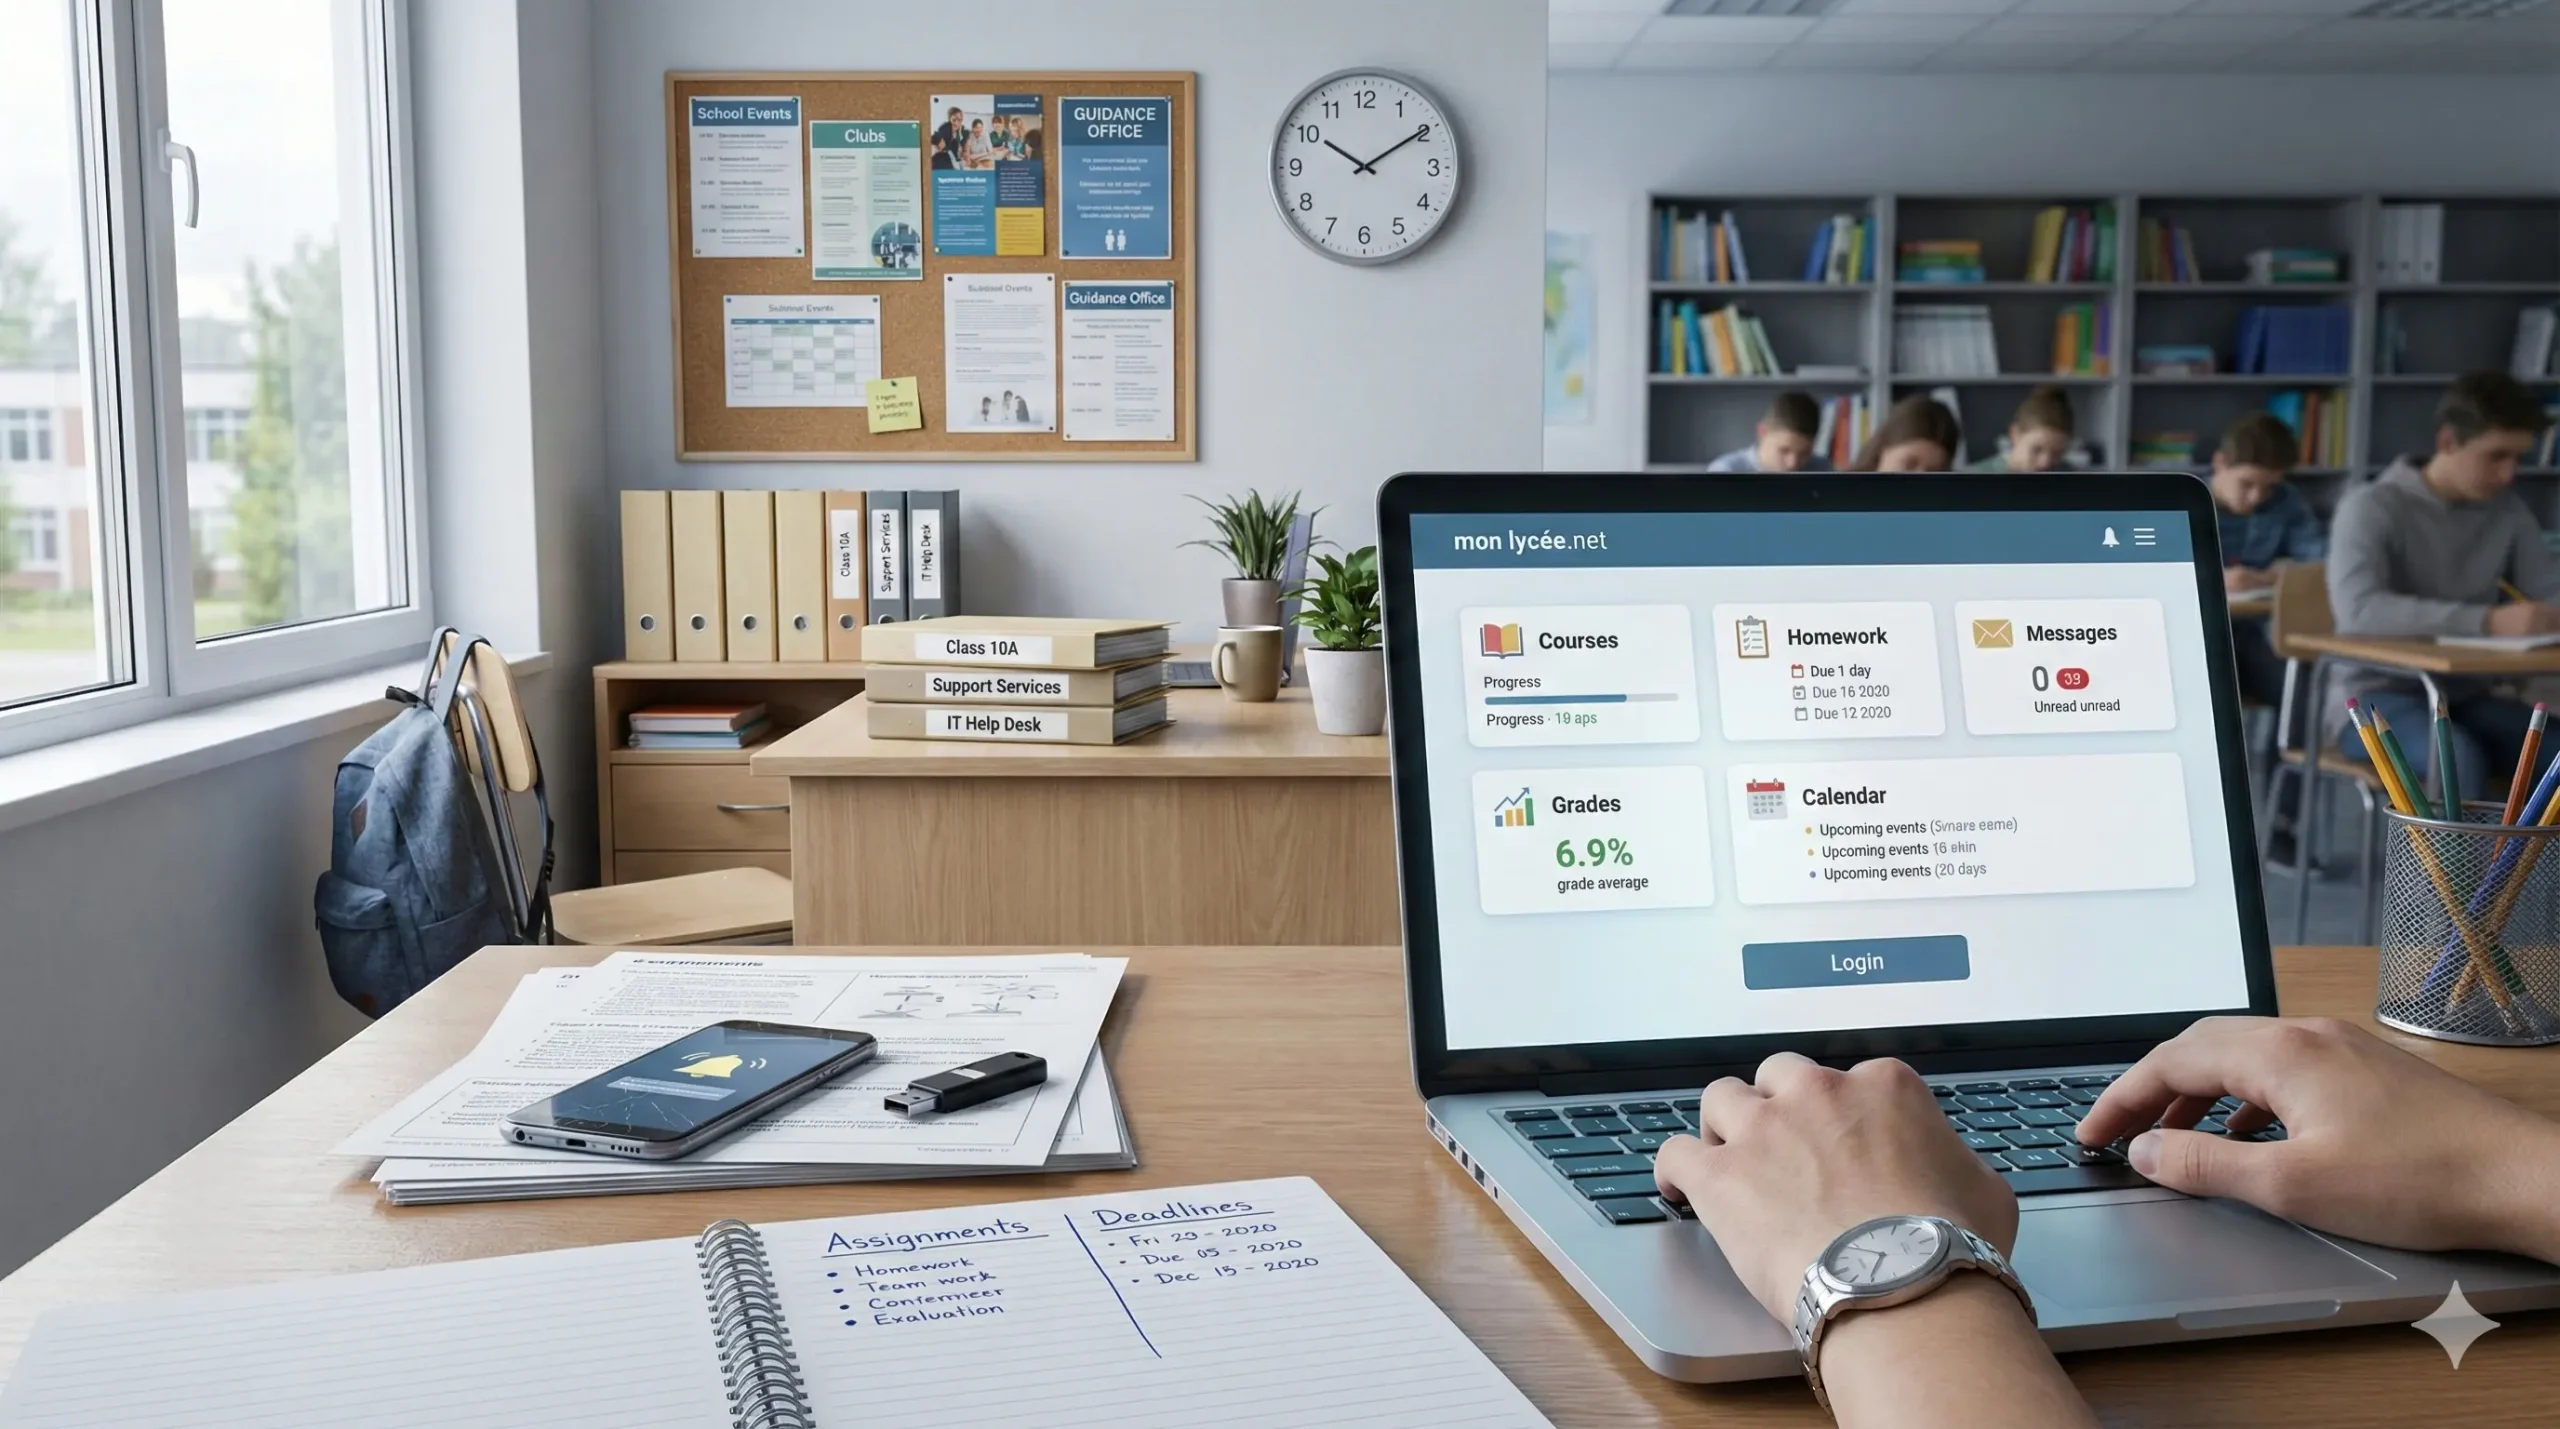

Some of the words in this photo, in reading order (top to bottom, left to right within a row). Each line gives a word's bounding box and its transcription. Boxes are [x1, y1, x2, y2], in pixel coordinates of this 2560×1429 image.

[1353, 90, 1376, 109] 12
[698, 107, 743, 120] School
[747, 108, 792, 120] Events
[1074, 107, 1156, 121] GUIDANCE
[1321, 101, 1339, 119] 11
[1395, 100, 1403, 118] 1
[844, 129, 886, 143] Clubs
[1086, 124, 1143, 138] OFFICE
[1297, 124, 1320, 143] 10
[1417, 124, 1430, 142] 2
[1289, 158, 1302, 177] 9
[1427, 158, 1440, 177] 3
[1299, 193, 1312, 211] 8
[1416, 193, 1430, 210] 4
[1325, 217, 1337, 235] 7
[1358, 226, 1370, 244] 6
[1392, 217, 1405, 235] 5
[1069, 292, 1127, 304] Guidance
[1130, 292, 1166, 304] Office
[840, 531, 850, 549] 10A
[1454, 534, 1502, 550] mon
[1509, 530, 1608, 555] lycée.net
[881, 556, 894, 592] Support
[1538, 632, 1619, 650] Courses
[1787, 627, 1888, 645] Homework
[2026, 625, 2118, 645] Messages
[946, 639, 985, 655] Class
[990, 641, 1019, 656] 10A
[1810, 665, 1835, 677] Due
[1838, 665, 1845, 677] 1
[1849, 664, 1871, 679] day
[933, 678, 993, 696] Support
[996, 679, 1061, 694] Services
[1484, 676, 1542, 690] Progress
[1812, 686, 1837, 698] Due
[1840, 686, 1856, 698] 16
[1859, 685, 1890, 697] 2020
[1814, 708, 1839, 720] Due
[1842, 707, 1858, 719] 12
[1861, 706, 1892, 719] 2020
[2034, 700, 2077, 713] Unread
[2080, 699, 2121, 712] unread
[947, 715, 961, 730] IT
[966, 716, 1000, 734] Help
[1004, 717, 1042, 732] Desk
[1486, 713, 1544, 728] Progress
[1555, 711, 1571, 724] 19
[1575, 714, 1597, 728] aps
[1552, 794, 1622, 814] Grades
[1802, 786, 1887, 806] Calendar
[1819, 822, 1883, 838] Upcoming
[1886, 821, 1927, 835] events
[1556, 838, 1634, 868] 6.9%
[1822, 844, 1886, 860] Upcoming
[1888, 843, 1929, 856] events
[1824, 866, 1888, 882] Upcoming
[1890, 865, 1932, 878] events
[1958, 862, 1987, 878] days
[1557, 877, 1595, 894] grade
[1598, 877, 1649, 891] average
[1831, 952, 1884, 975] Login
[1092, 1201, 1253, 1226] Deadlines
[827, 1218, 1030, 1252] Assignments
[1129, 1235, 1160, 1247] Fri
[1222, 1223, 1277, 1236] 2020
[1140, 1253, 1184, 1265] Due
[1247, 1239, 1302, 1254] 2020
[854, 1257, 974, 1277] Homework
[1154, 1272, 1200, 1285] Dec
[1214, 1265, 1237, 1277] 15
[1264, 1257, 1319, 1272] 2020
[858, 1281, 927, 1293] Team
[938, 1270, 997, 1286] work
